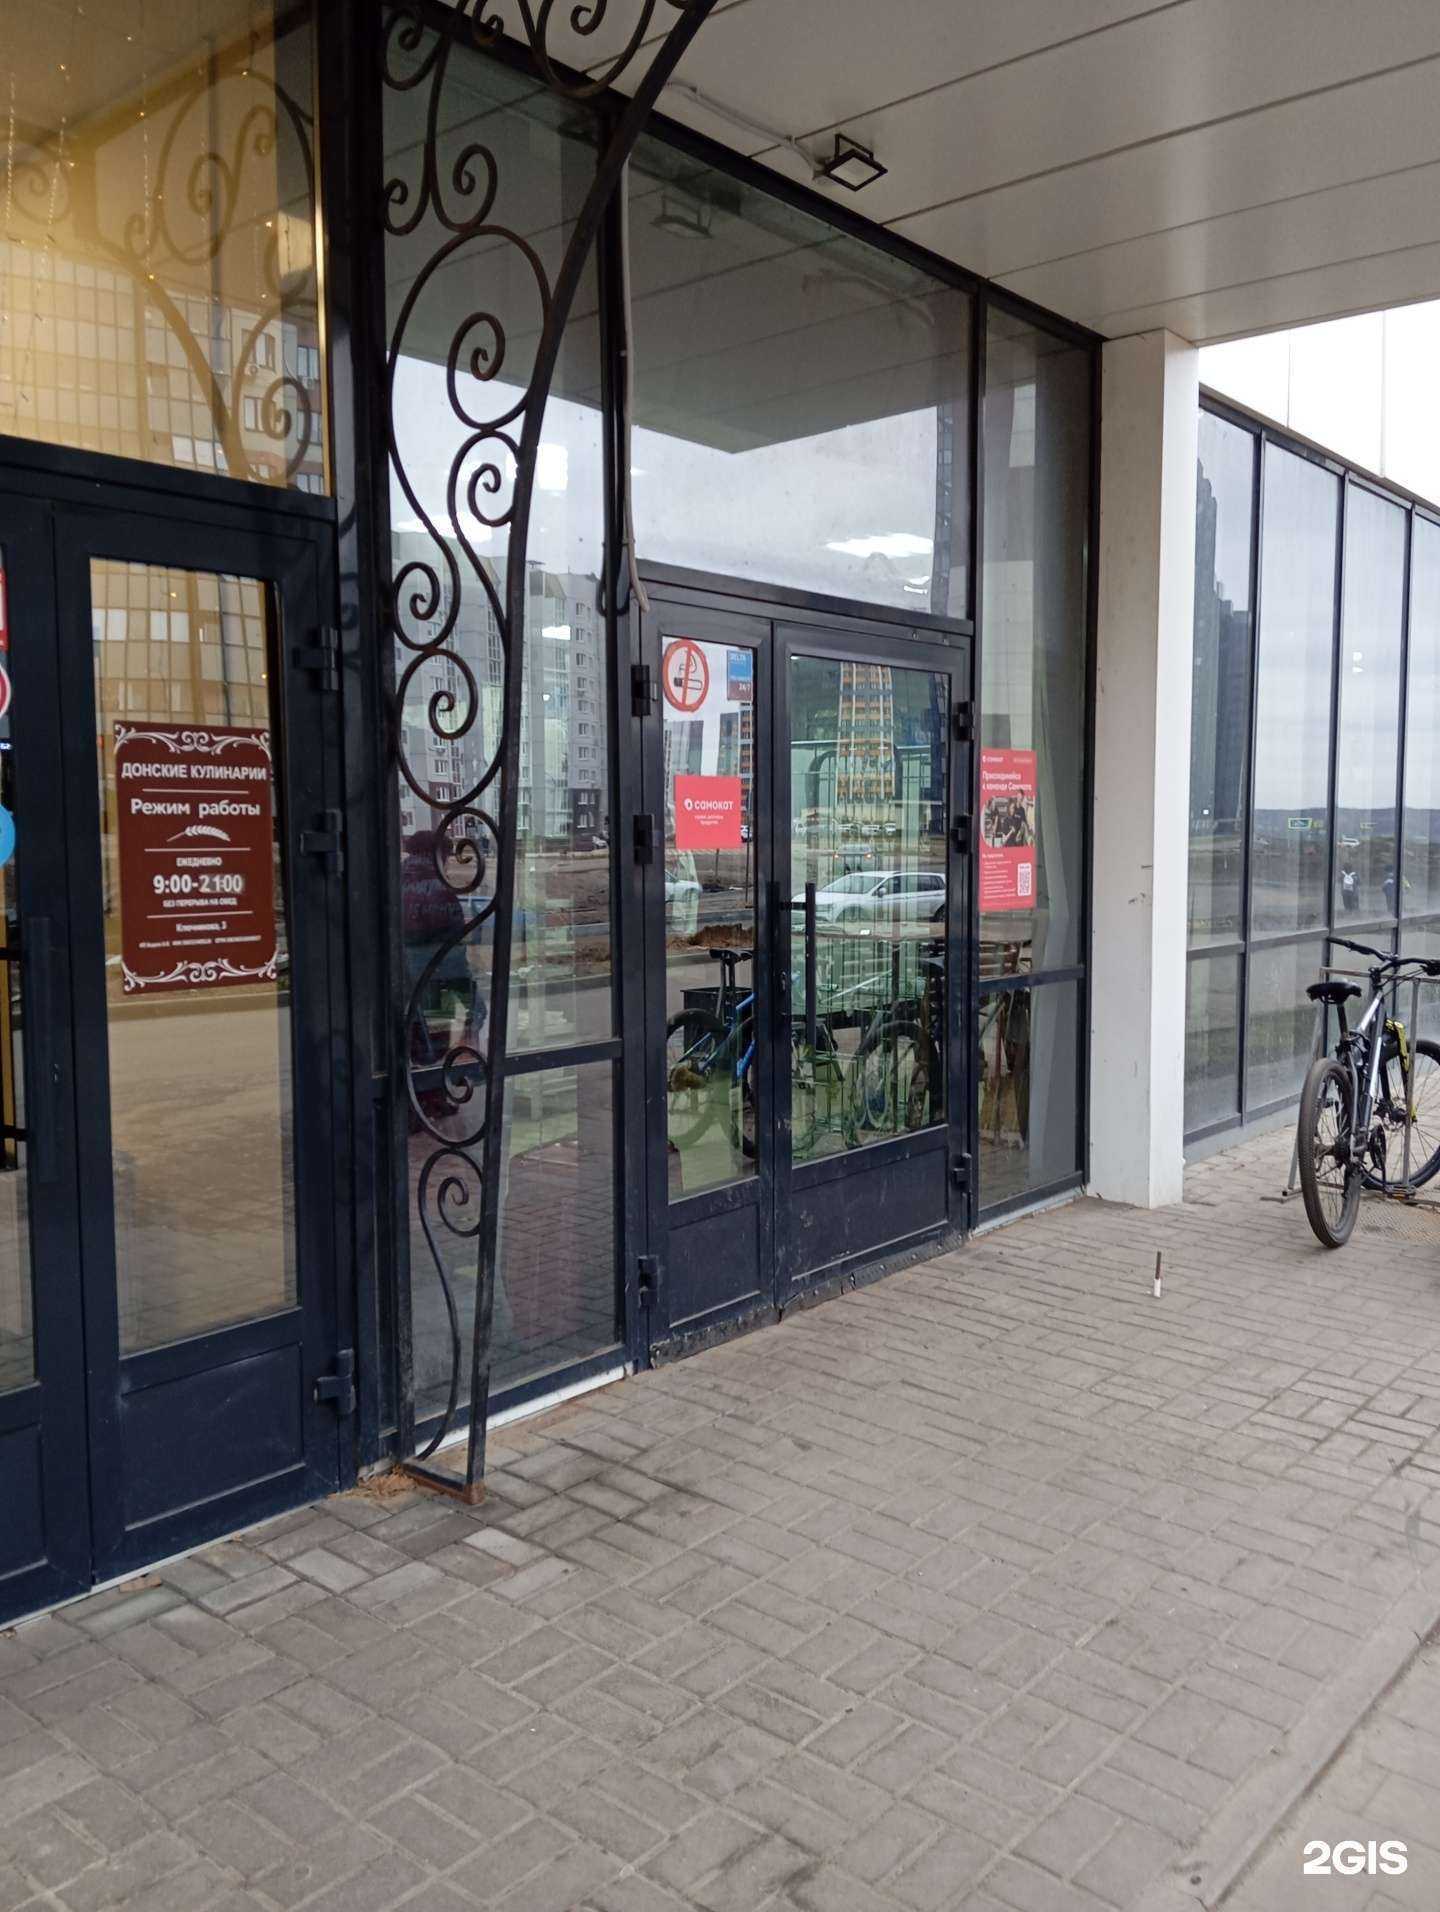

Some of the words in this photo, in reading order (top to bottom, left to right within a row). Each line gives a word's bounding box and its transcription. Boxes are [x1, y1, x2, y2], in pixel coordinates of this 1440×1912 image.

[121, 763, 188, 779] ДОНСКИЕ
[190, 765, 267, 780] КУЛИНАРИИ
[131, 799, 191, 815] Режим
[198, 800, 261, 818] работы
[694, 800, 734, 810] самокат
